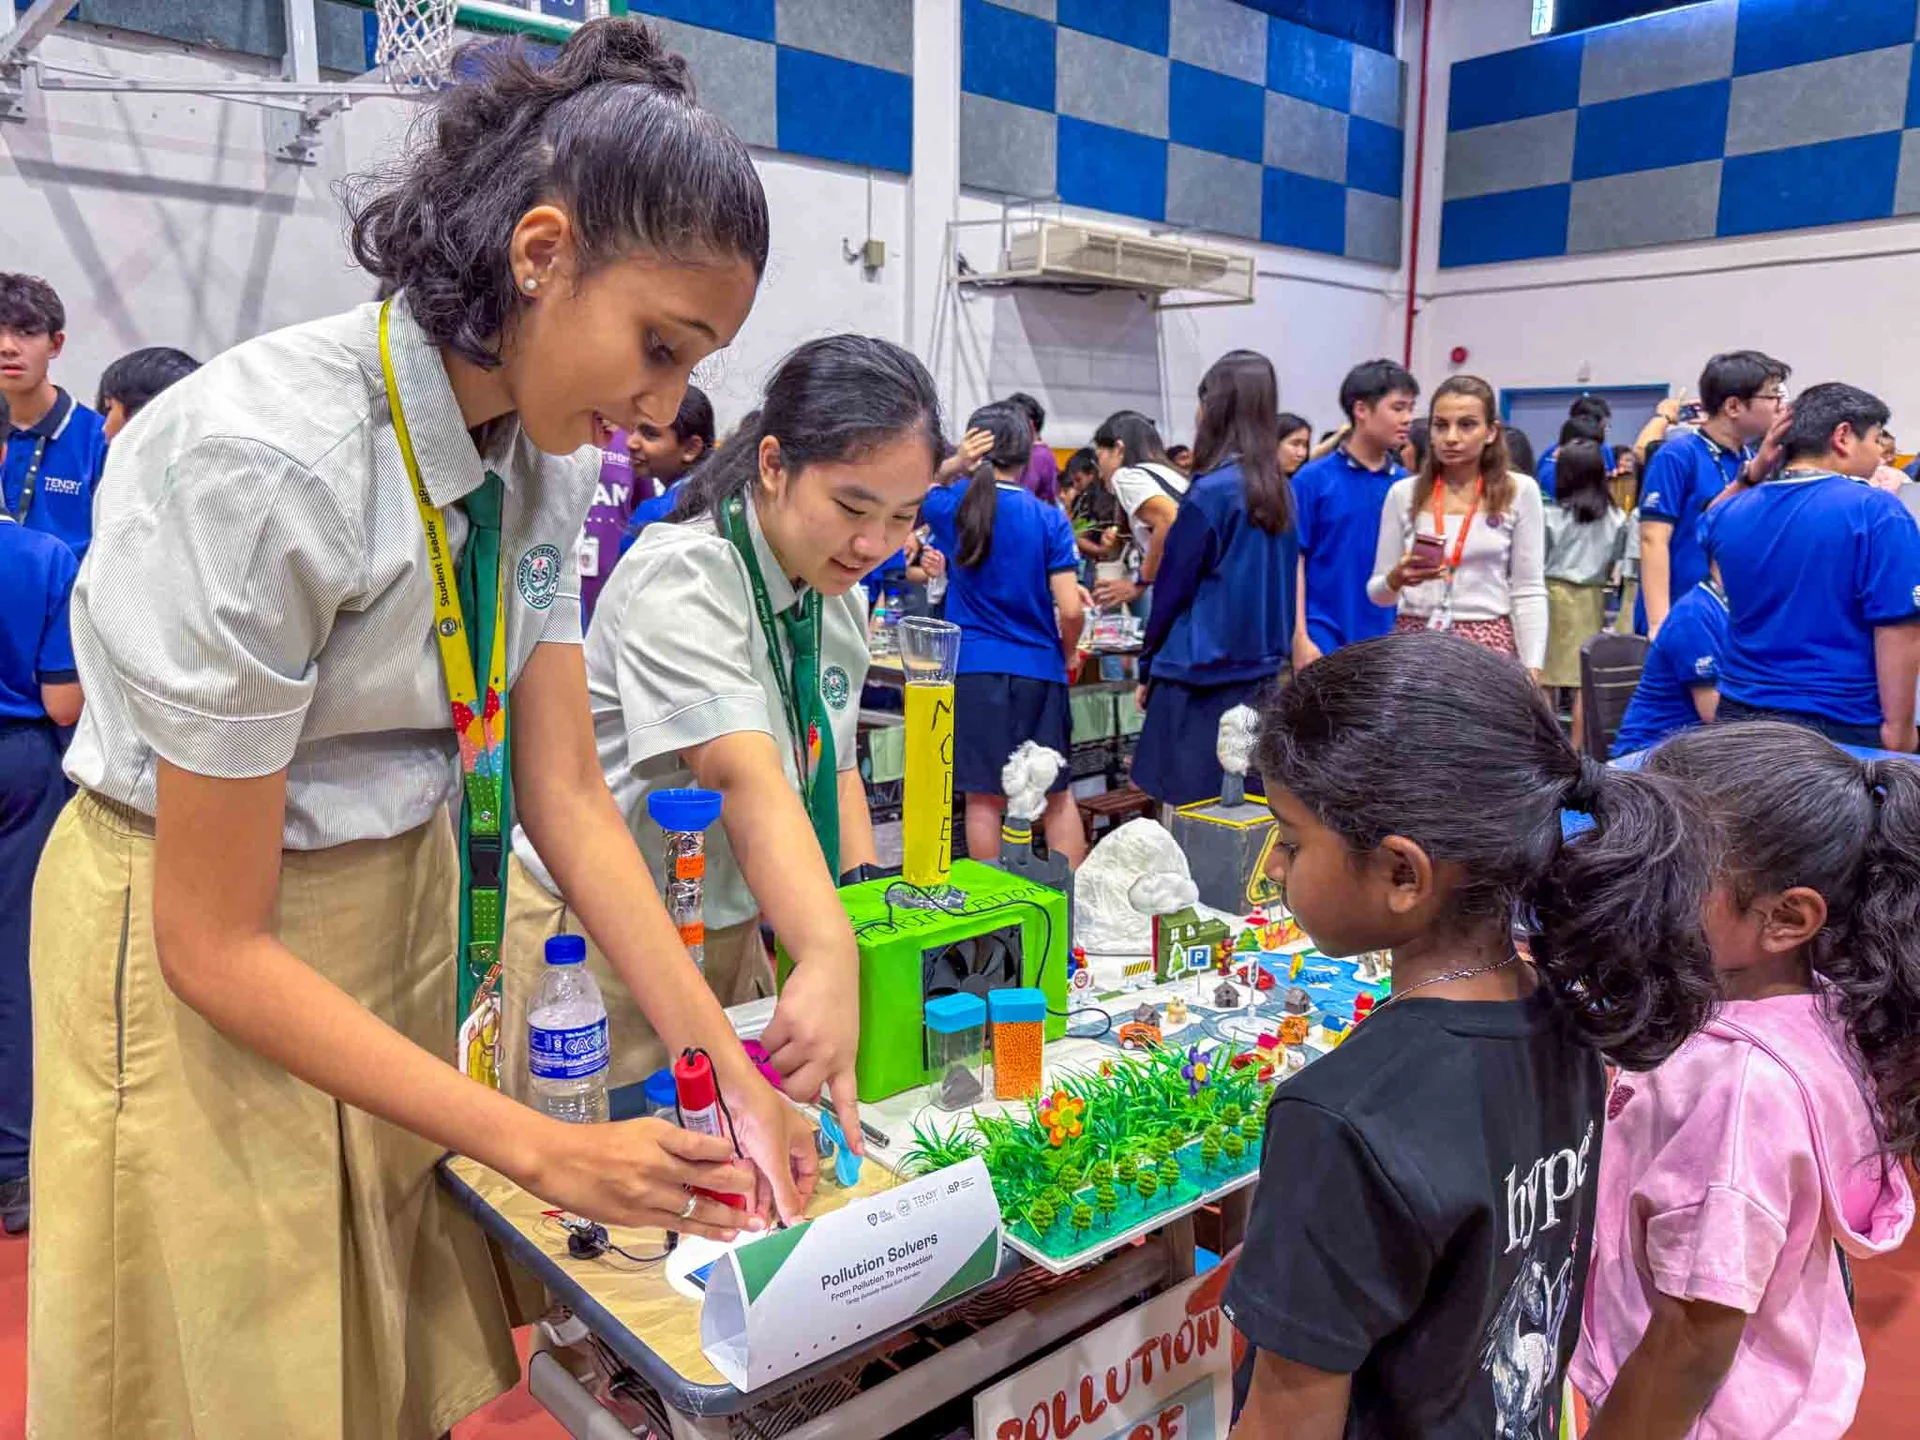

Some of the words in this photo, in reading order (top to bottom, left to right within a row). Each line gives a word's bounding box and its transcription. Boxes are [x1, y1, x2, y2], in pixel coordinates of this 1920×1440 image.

[427, 519, 441, 561] Leader
[432, 561, 450, 608] Student
[1193, 951, 1204, 963] P
[821, 1256, 885, 1291] Pollution
[887, 1233, 938, 1263] Solvers
[831, 1289, 852, 1303] From
[852, 1273, 885, 1294] Pollution
[885, 1270, 895, 1280] To
[895, 1253, 933, 1276] Protection
[996, 1308, 1221, 1440] POLLUTION
